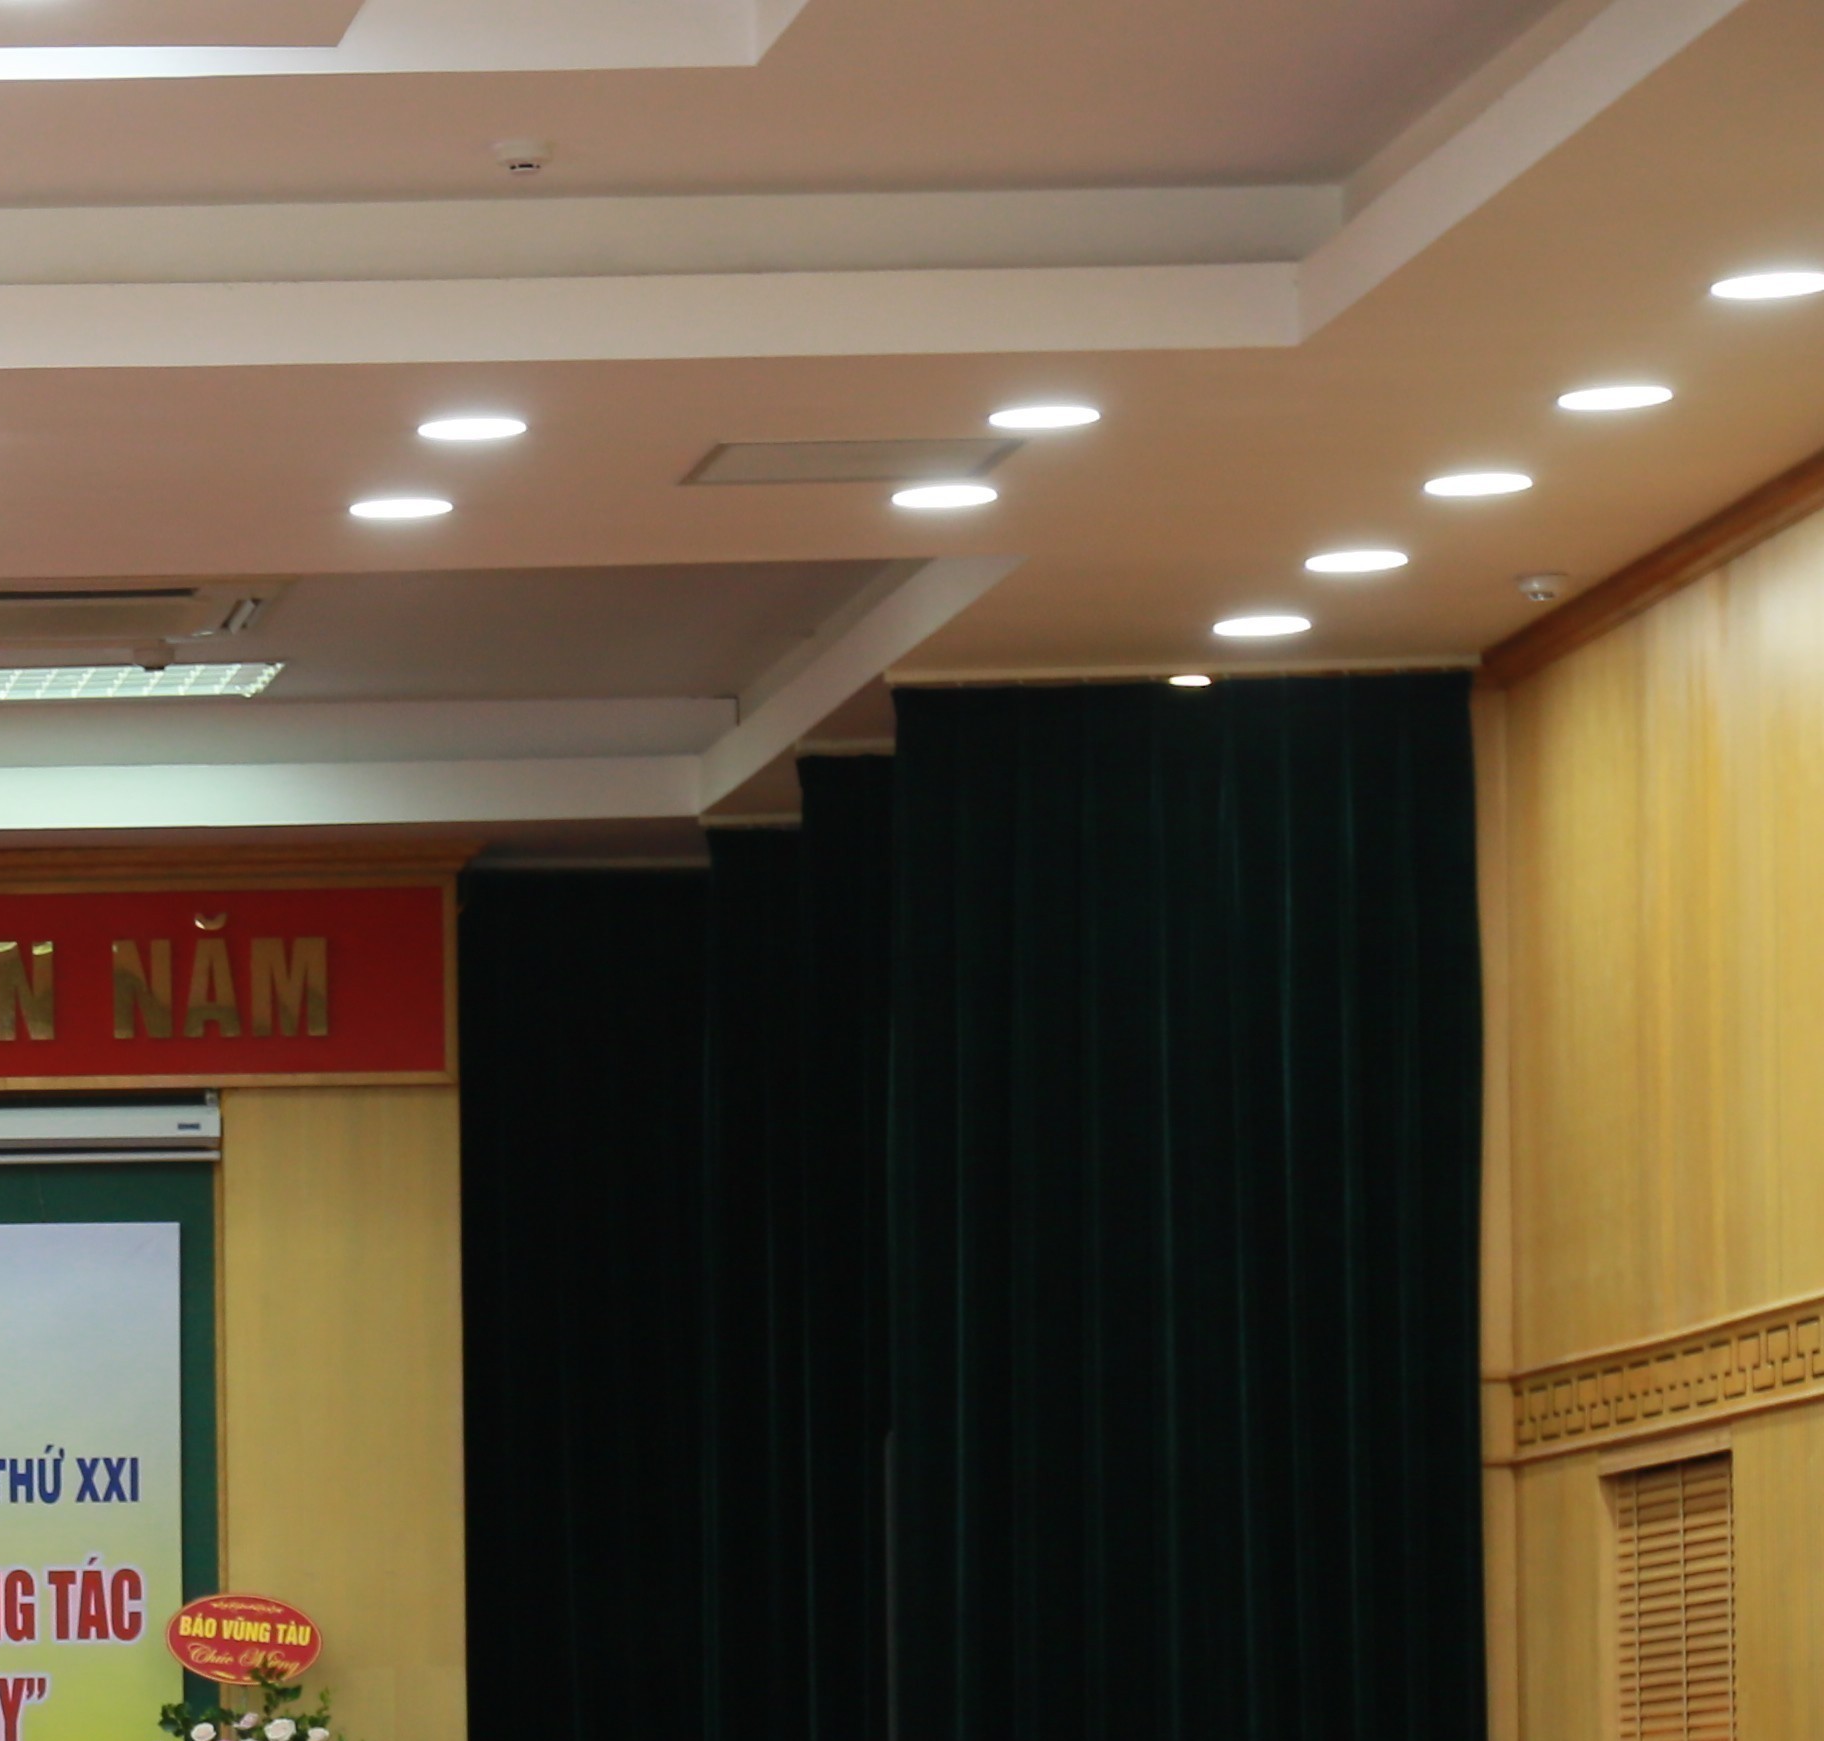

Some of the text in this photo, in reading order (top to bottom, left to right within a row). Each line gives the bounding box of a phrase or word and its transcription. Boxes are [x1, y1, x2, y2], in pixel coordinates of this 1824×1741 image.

[111, 910, 332, 1041] NĂM
[76, 1456, 140, 1503] XXI
[47, 1556, 143, 1641] TÁC
[179, 1612, 312, 1647] BÁO VŨNG TÀU
